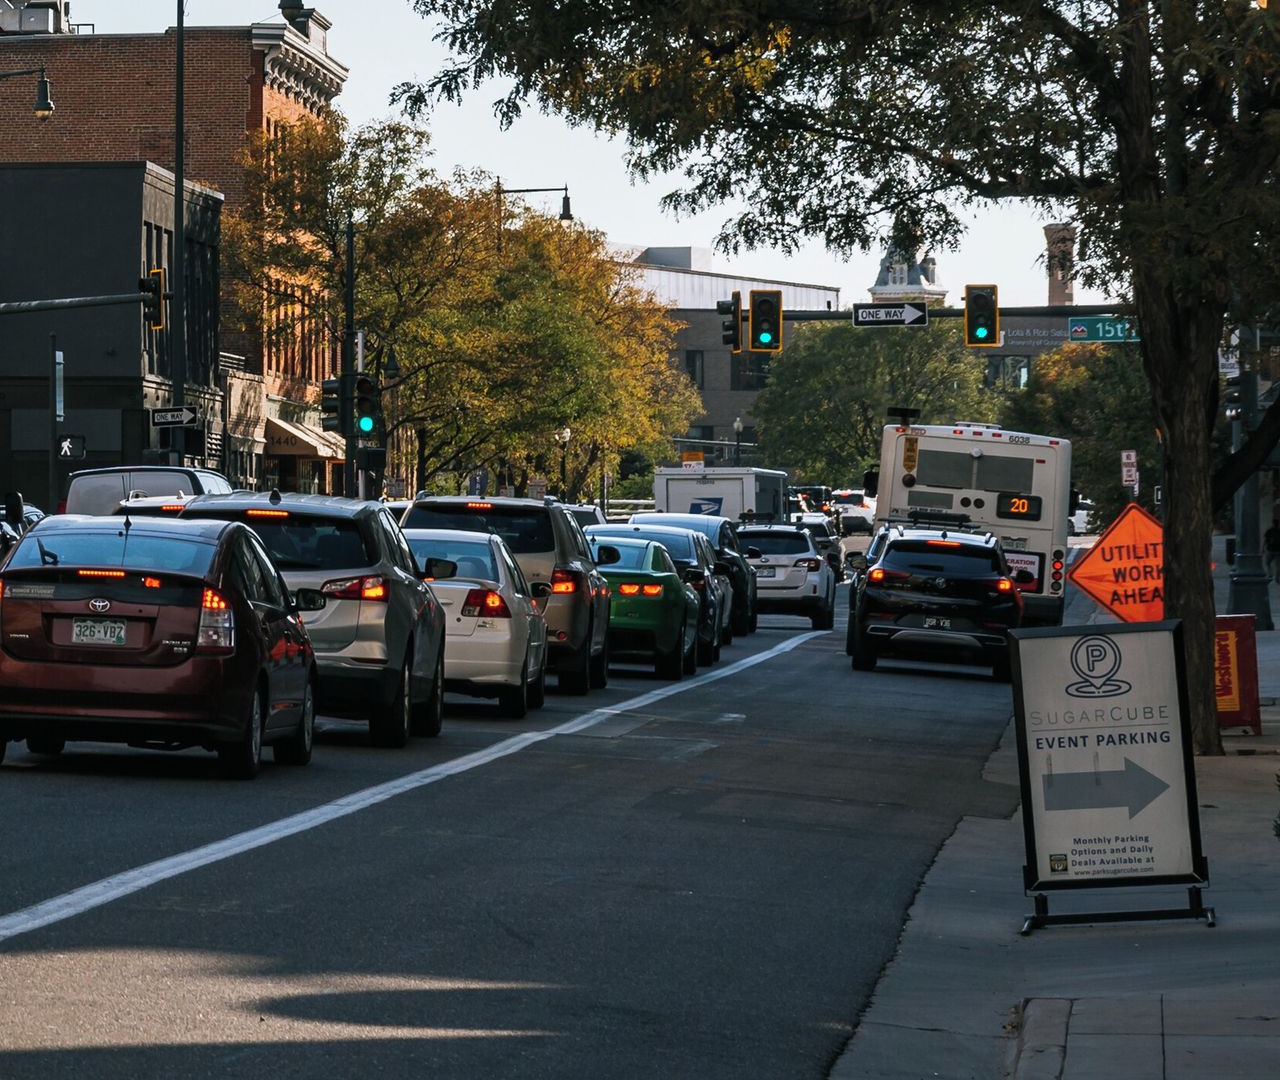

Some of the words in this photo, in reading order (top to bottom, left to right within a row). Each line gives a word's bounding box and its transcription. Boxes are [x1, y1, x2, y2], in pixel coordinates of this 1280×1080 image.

[861, 309, 882, 320] ONE
[884, 308, 905, 320] WAY
[156, 413, 169, 421] ONE
[271, 436, 297, 447] 1440
[1009, 435, 1030, 445] 6038
[1010, 498, 1029, 513] 20
[1101, 542, 1163, 562] UTILIT
[1110, 586, 1164, 606] AHEA
[1031, 705, 1169, 726] SUGARCUBE
[1036, 735, 1089, 750] EVENT
[1096, 730, 1171, 747] PARKING
[1073, 837, 1111, 845] Monthly
[1115, 835, 1150, 843] Parking
[1071, 848, 1107, 857] Options
[1130, 846, 1154, 854] Daily
[1071, 859, 1096, 867] Deals
[1099, 857, 1143, 865] Available
[1073, 867, 1155, 876] www.parksugarcube.com
